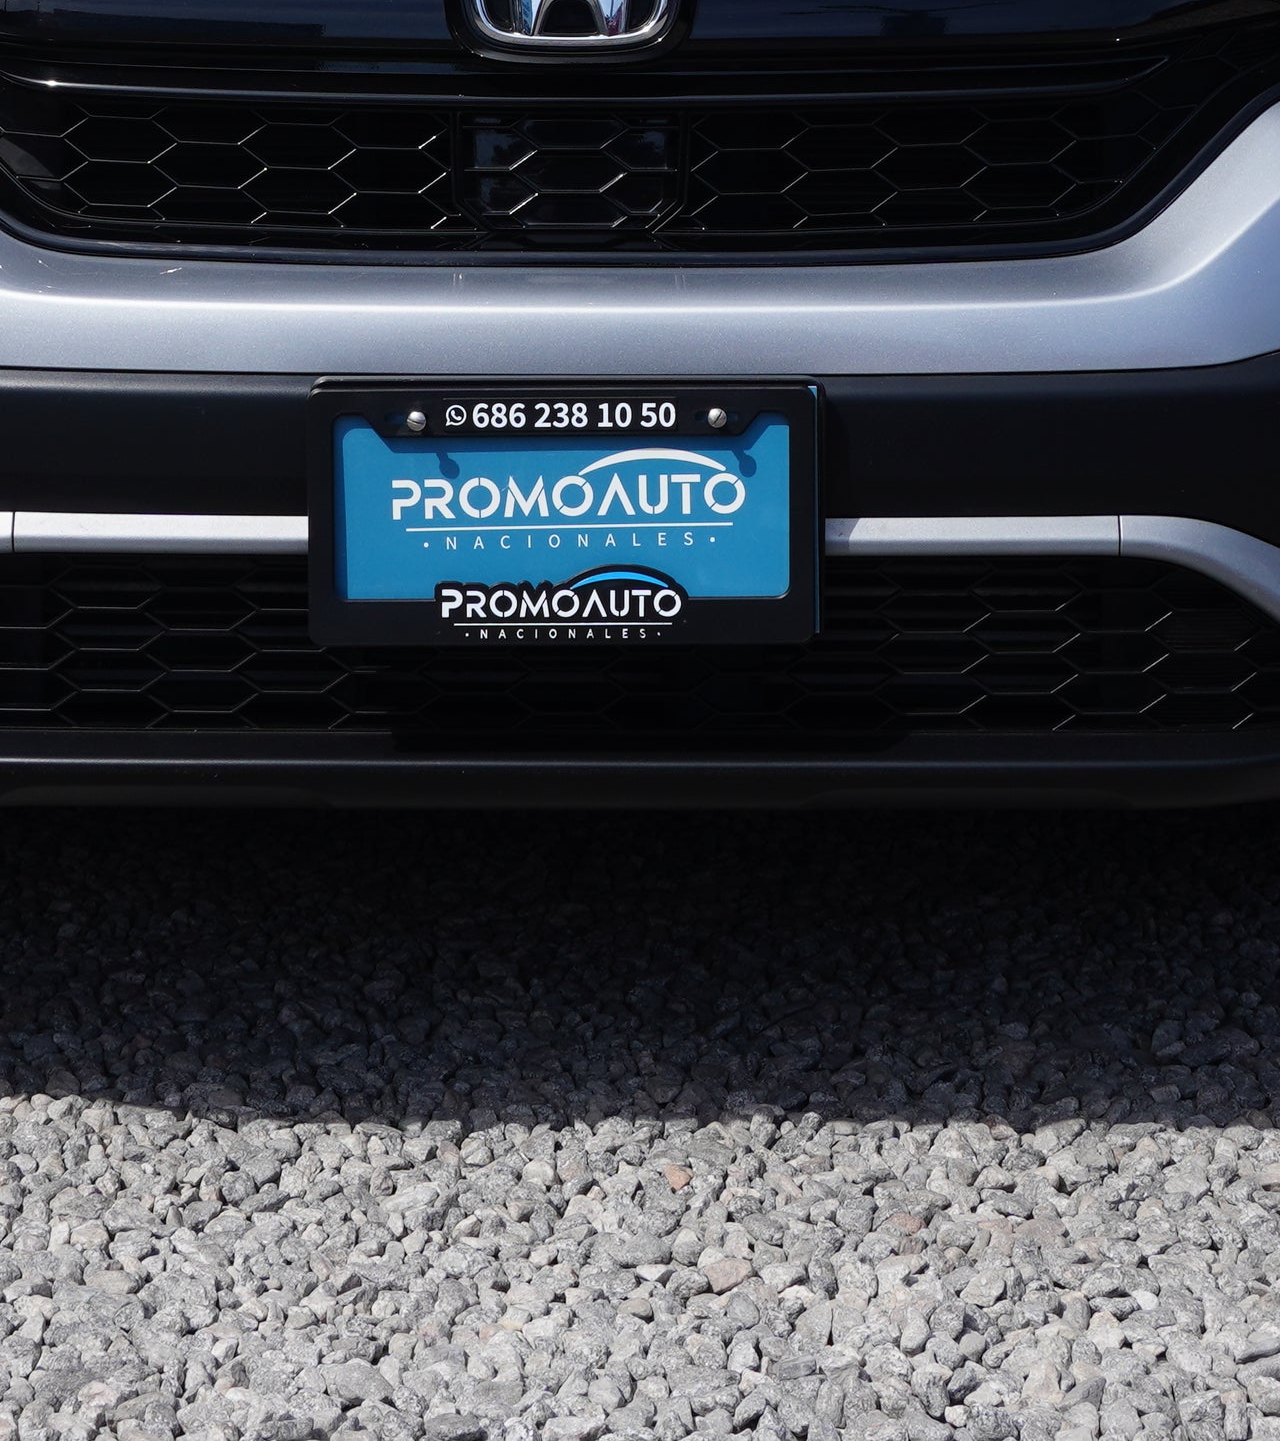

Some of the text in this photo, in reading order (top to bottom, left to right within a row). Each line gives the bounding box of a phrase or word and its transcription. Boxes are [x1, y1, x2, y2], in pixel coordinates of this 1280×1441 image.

[472, 402, 676, 428] 686 238 10 50
[391, 472, 746, 521] PROMOAUTO
[445, 531, 694, 551] NACIONALES
[441, 588, 682, 618] PROMOAUTO
[479, 628, 647, 639] NACIONALES
